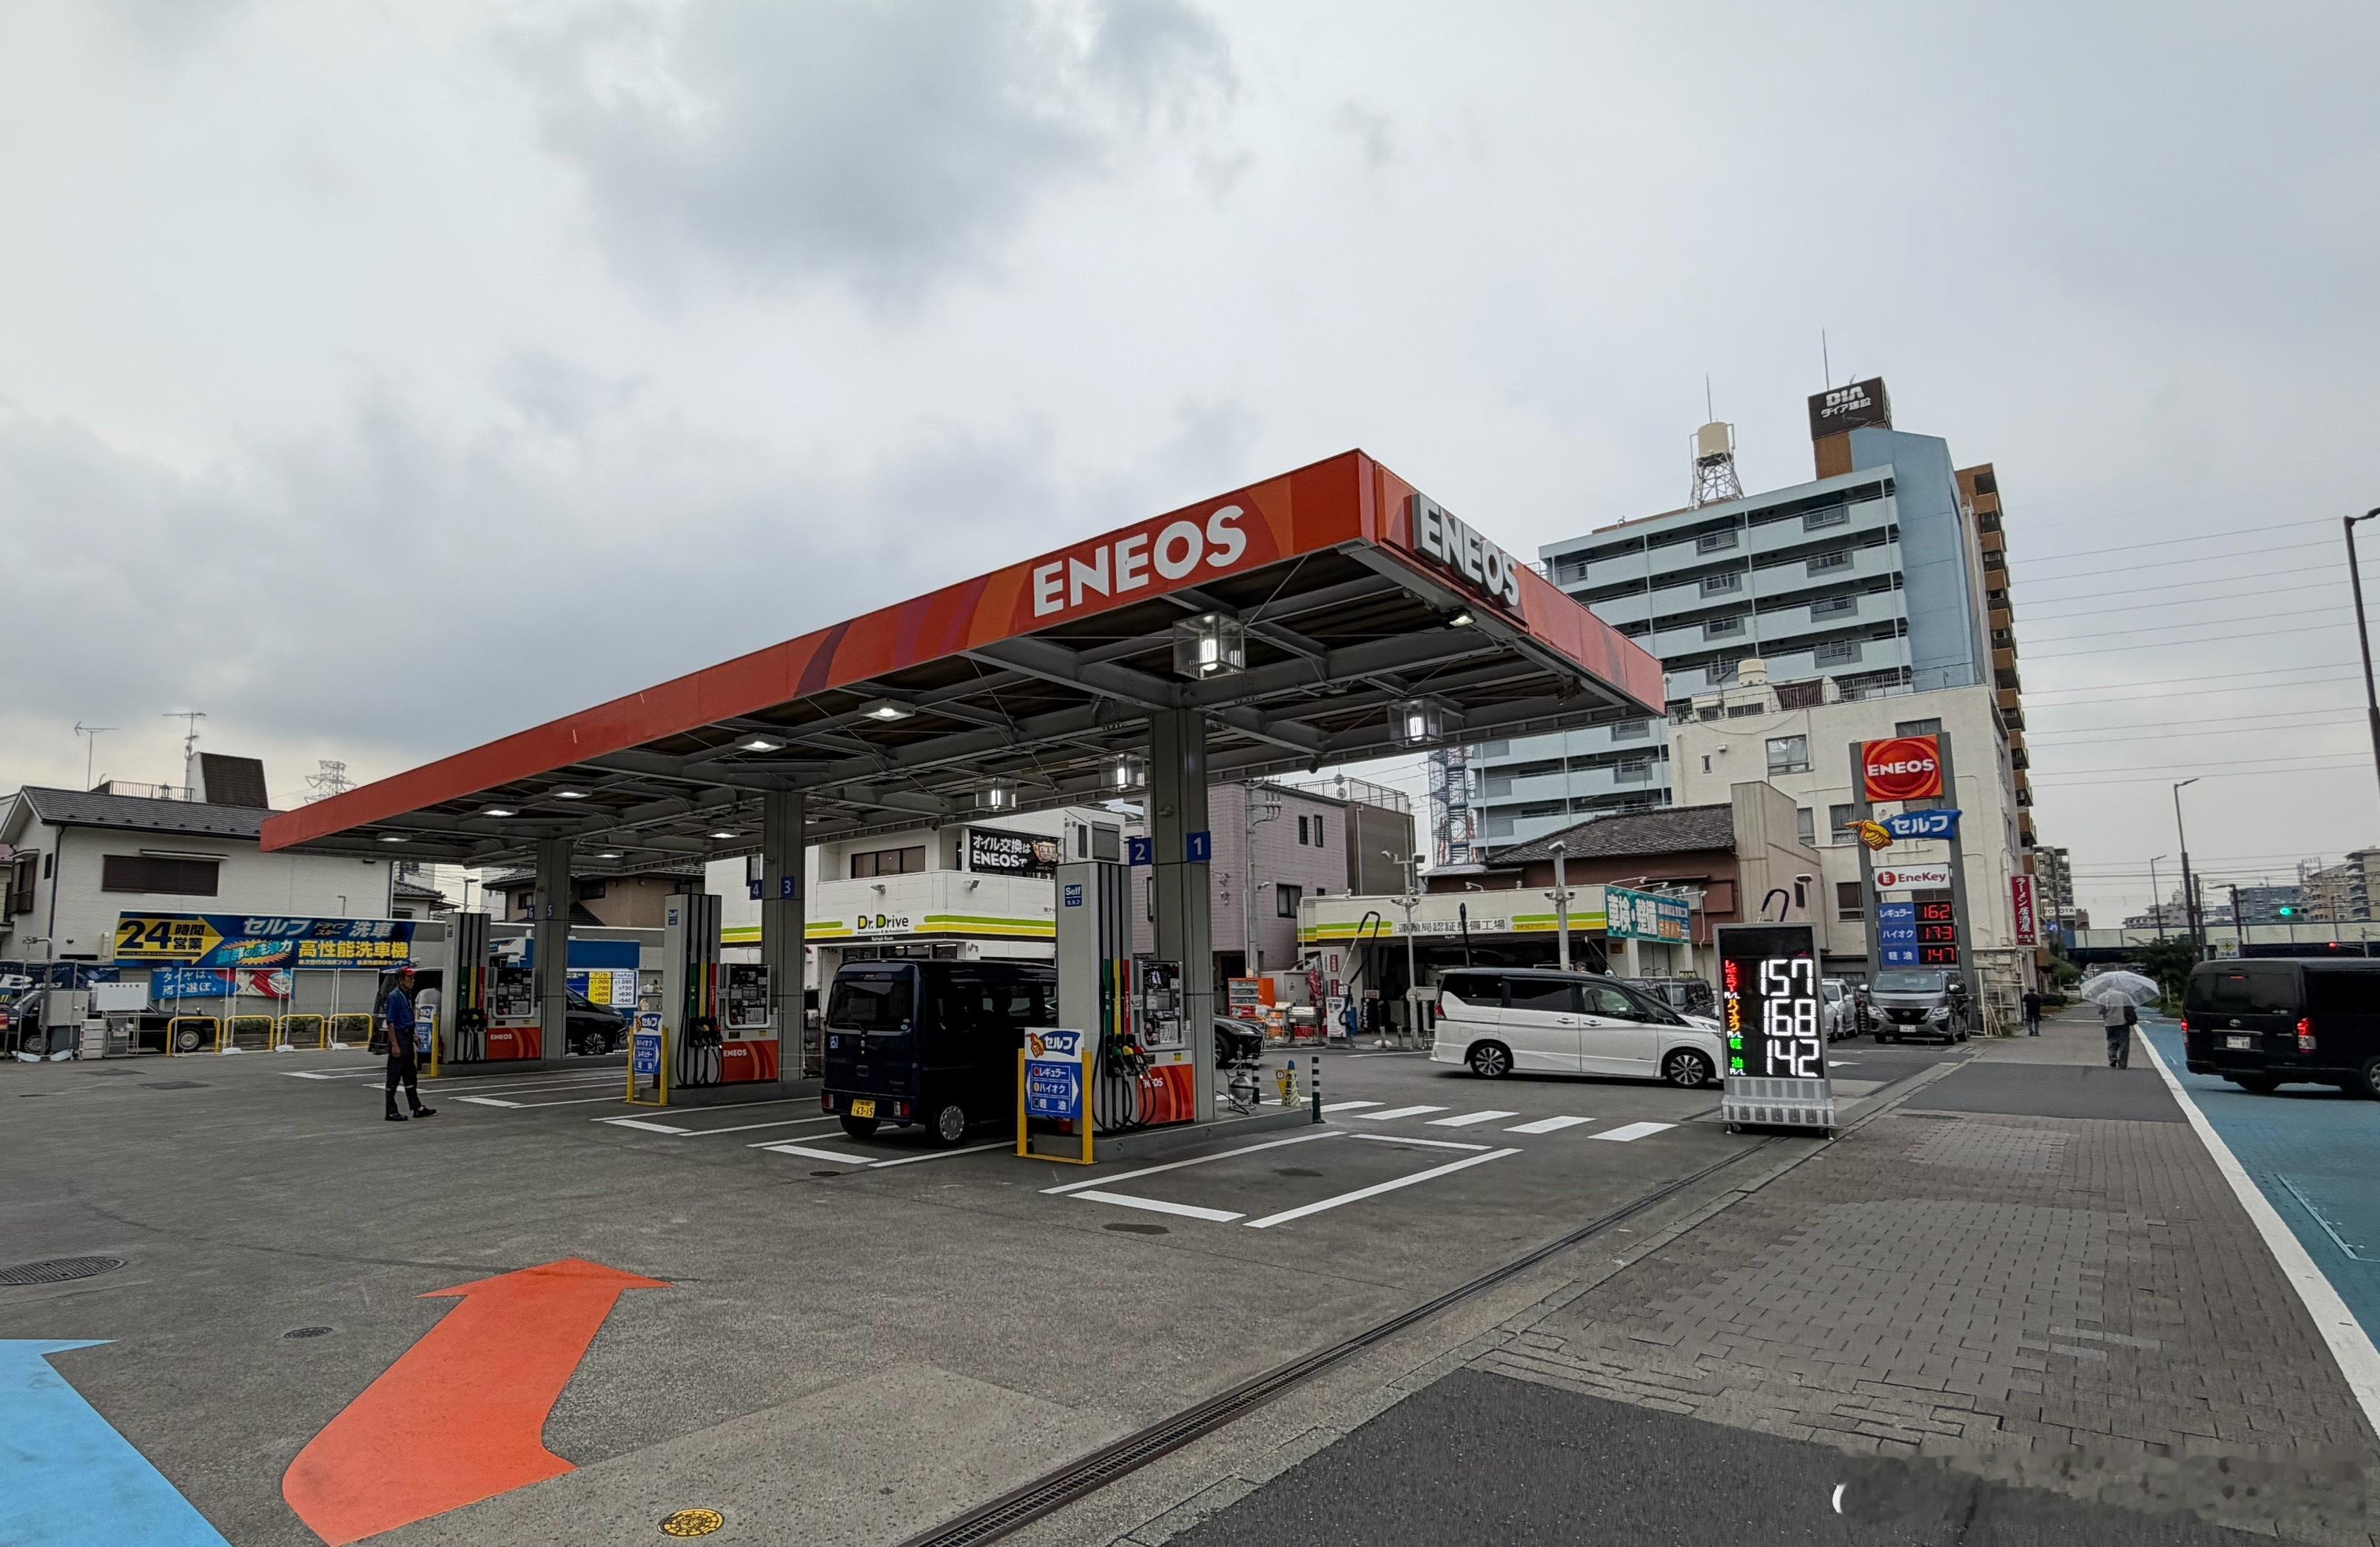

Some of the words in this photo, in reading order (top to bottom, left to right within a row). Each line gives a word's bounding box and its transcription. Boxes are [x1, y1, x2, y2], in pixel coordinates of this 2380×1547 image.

[1413, 494, 1519, 606] ENEOS
[1034, 506, 1246, 617] ENEOS
[1867, 759, 1934, 776] ENEOS
[1892, 816, 1948, 834] セルフ
[973, 835, 1031, 854] オイル交換は
[1135, 843, 1146, 861] 2
[1194, 837, 1202, 856] 1
[973, 850, 1027, 868] ENEOSで
[1898, 873, 1946, 883] EneKey
[752, 883, 759, 896] 4
[784, 880, 791, 894] 3
[1066, 887, 1080, 896] Self
[548, 905, 552, 916] 5
[1924, 905, 1950, 919] 162
[2015, 877, 2031, 932] ラーメン居酒屋
[528, 907, 534, 918] 6
[1607, 893, 1657, 935] 車検・整備
[1880, 908, 1912, 918] レギュラー
[117, 921, 172, 950] 24
[174, 924, 206, 936] 時間
[243, 918, 311, 936] セルフ
[349, 921, 395, 938] 洗車
[1882, 930, 1914, 939] ハイオク
[1926, 926, 1952, 940] 173
[173, 937, 203, 950] 営業
[298, 940, 409, 959] 高性能洗車機
[1888, 951, 1913, 961] 軽油
[1927, 947, 1954, 962] 147
[163, 970, 212, 983] タイヤは、
[1760, 959, 1813, 996] 157
[642, 1018, 657, 1027] セルフ
[1727, 999, 1739, 1031] ハイオク
[1764, 999, 1816, 1036] 168
[1044, 1036, 1072, 1050] セルフ
[1766, 1038, 1820, 1077] 142
[1040, 1067, 1066, 1078] レギュラー
[1040, 1084, 1066, 1094] ハイオク
